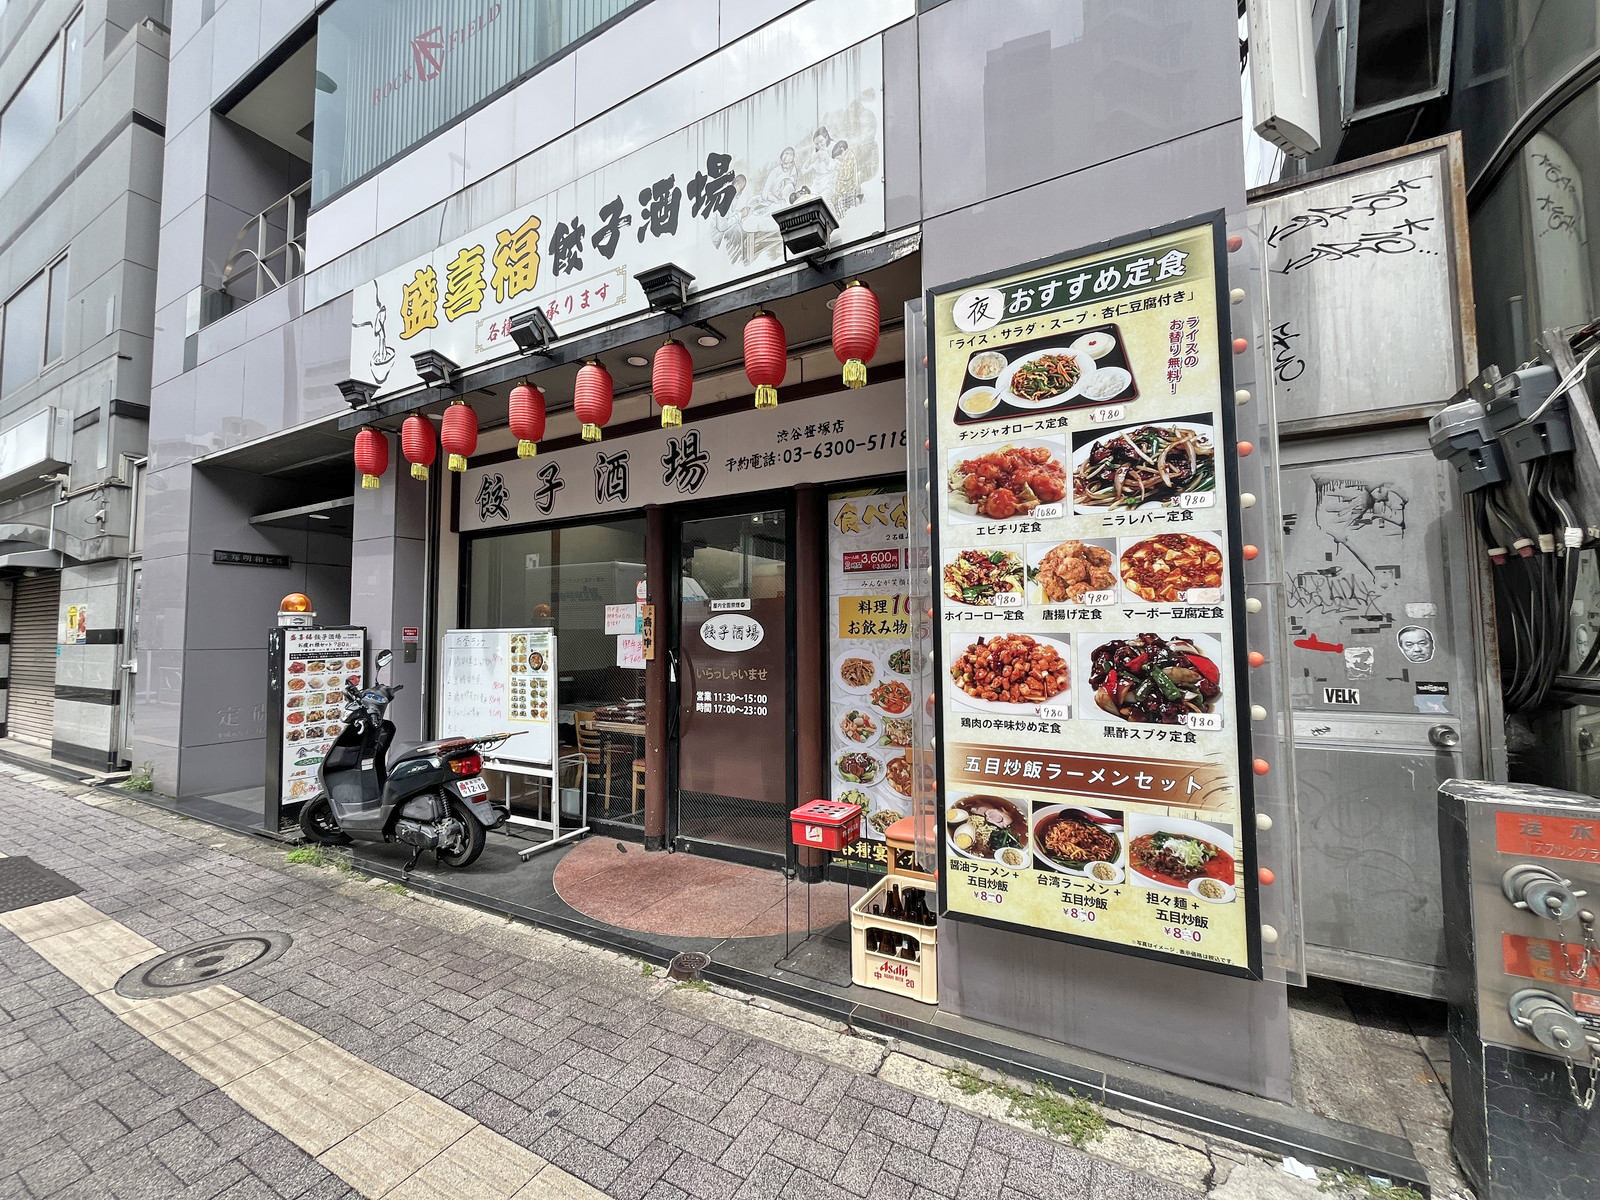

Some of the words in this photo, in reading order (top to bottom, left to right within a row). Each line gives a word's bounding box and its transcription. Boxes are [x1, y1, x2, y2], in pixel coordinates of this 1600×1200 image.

[373, 66, 412, 106] ROCK
[449, 4, 502, 53] FIELD
[400, 215, 541, 340] 盛喜福
[548, 153, 738, 277] 餃子酒場
[1007, 249, 1188, 312] おすすめ定食
[487, 283, 609, 341] 各種承ります
[966, 296, 997, 326] 夜
[1184, 316, 1199, 368] ライスの
[777, 420, 845, 443] 渋谷笹塚店
[958, 416, 1069, 441] チンジャオロース定食
[475, 429, 711, 522] 餃子酒場
[1101, 509, 1194, 527] ニラレバー定食
[976, 522, 1042, 537] エビチリ定食
[944, 609, 1025, 621] ホイコーロー定食
[1042, 608, 1102, 621] 唐揚げ定食
[1122, 606, 1224, 620] マーボー豆腐定食
[703, 624, 760, 641] 餃子酒場
[696, 668, 768, 681] いらっしゃいませ
[696, 691, 712, 701] 営業
[1325, 688, 1358, 704] VELK
[696, 703, 712, 713] 時間
[960, 717, 1062, 735] 鶏肉の辛味炒め定食
[963, 755, 1203, 796] 五目炒飯ラーメンセット
[967, 875, 1009, 892] 五目炒飯
[973, 891, 1003, 904] ¥80
[1061, 892, 1108, 911] 五目炒飯
[1063, 908, 1096, 922] ¥80
[1155, 909, 1209, 930] 五目炒飯
[1164, 926, 1202, 943] ¥80
[880, 961, 908, 977] Asahi
[905, 979, 915, 989] 20
